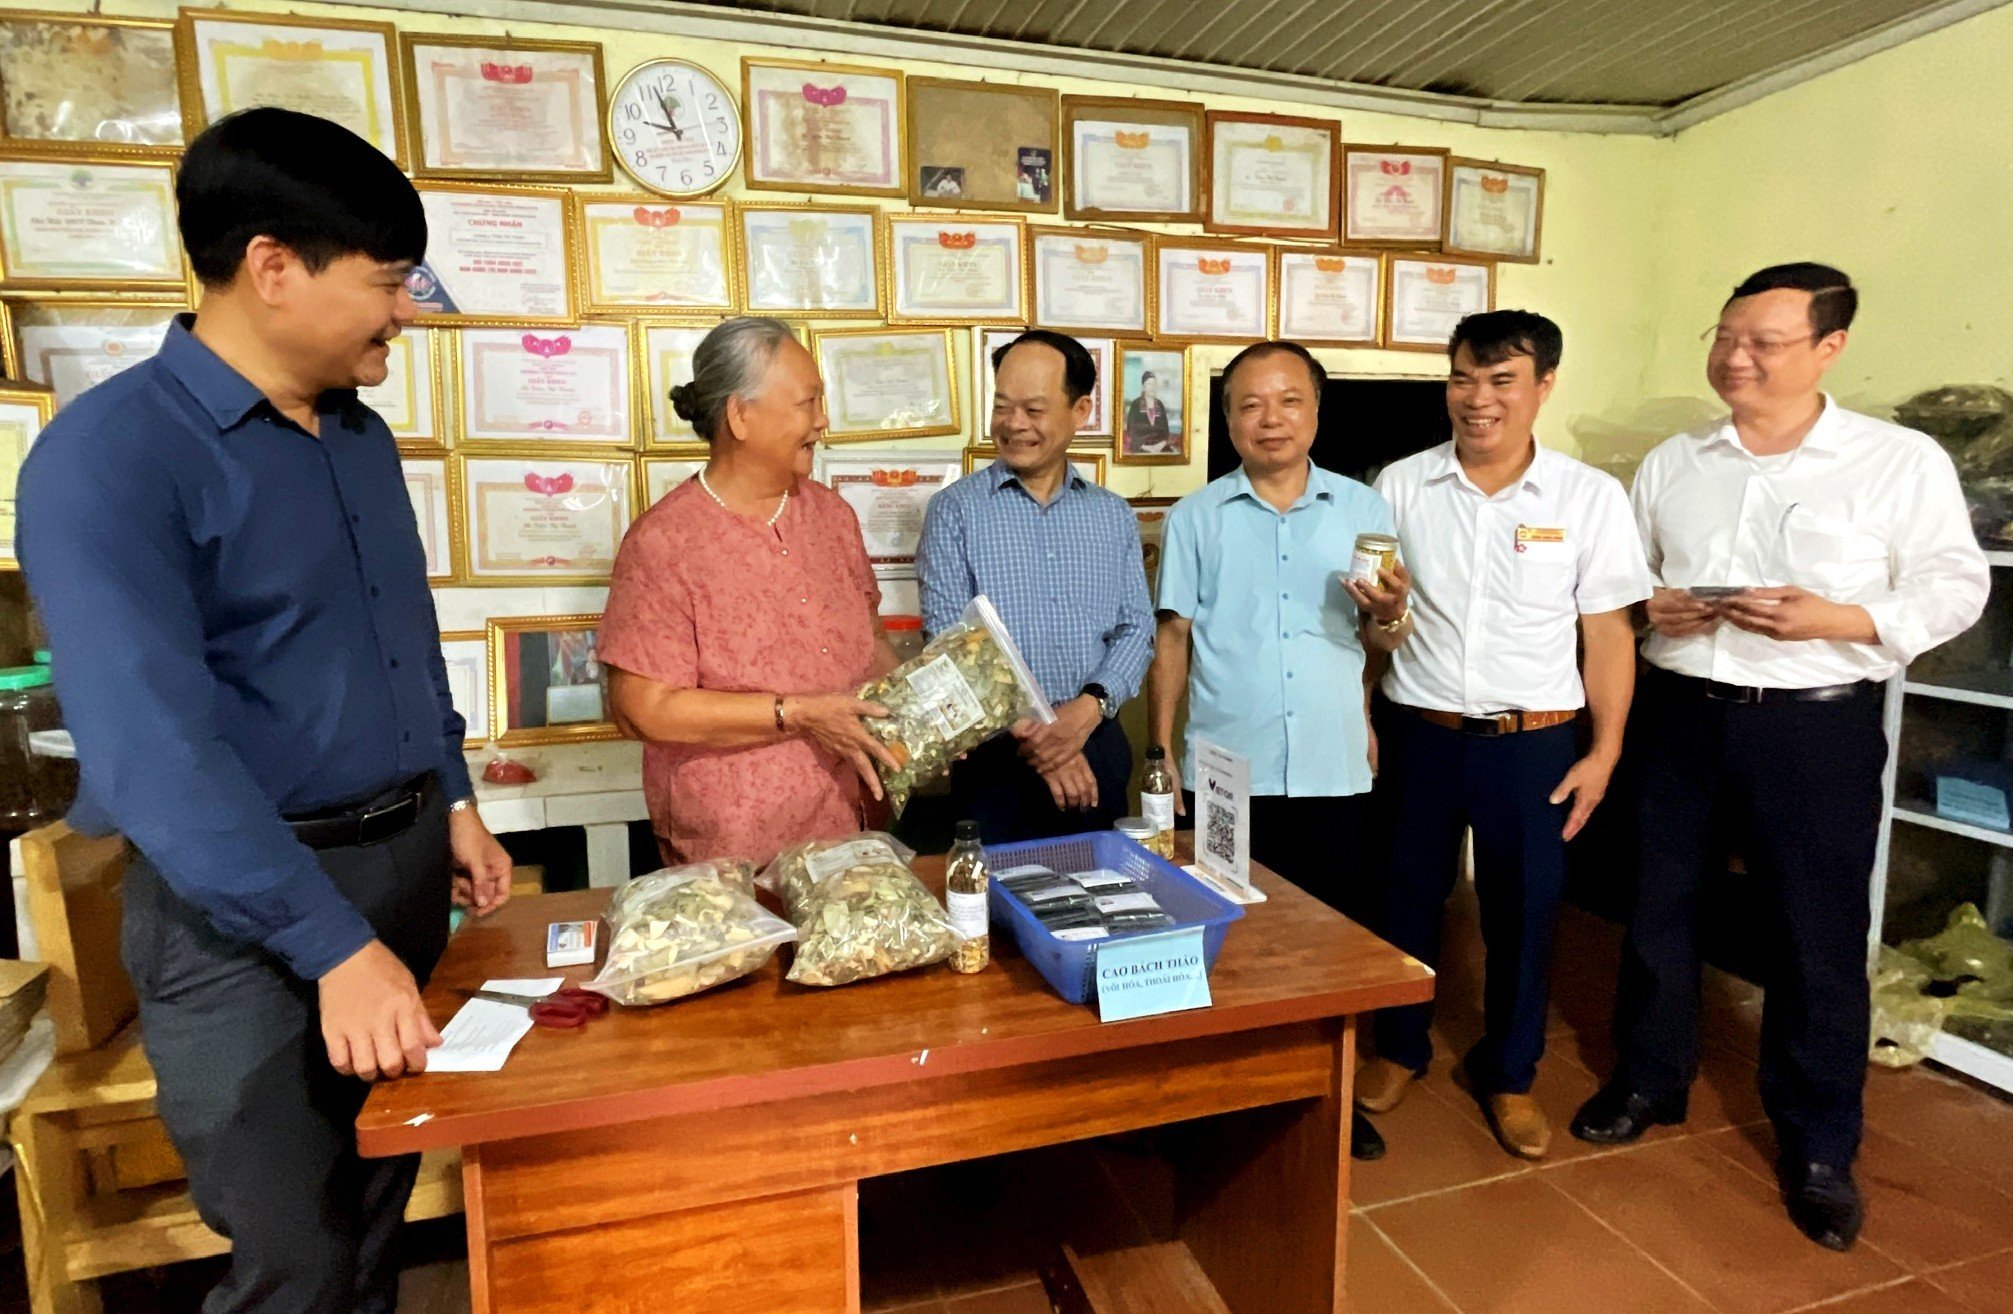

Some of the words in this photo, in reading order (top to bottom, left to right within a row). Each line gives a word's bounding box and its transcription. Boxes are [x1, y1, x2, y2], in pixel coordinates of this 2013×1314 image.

[658, 74, 676, 93] 12
[638, 84, 653, 102] 11
[705, 93, 719, 110] 2
[624, 102, 642, 121] 10
[716, 116, 729, 134] 3
[623, 128, 636, 145] 9
[716, 140, 727, 156] 4
[635, 150, 648, 168] 8
[656, 165, 667, 182] 7
[702, 160, 715, 177] 5
[680, 169, 693, 186] 6
[1102, 966, 1128, 979] CAO
[1131, 960, 1163, 976] BÁCH
[1166, 954, 1199, 969] THẢO
